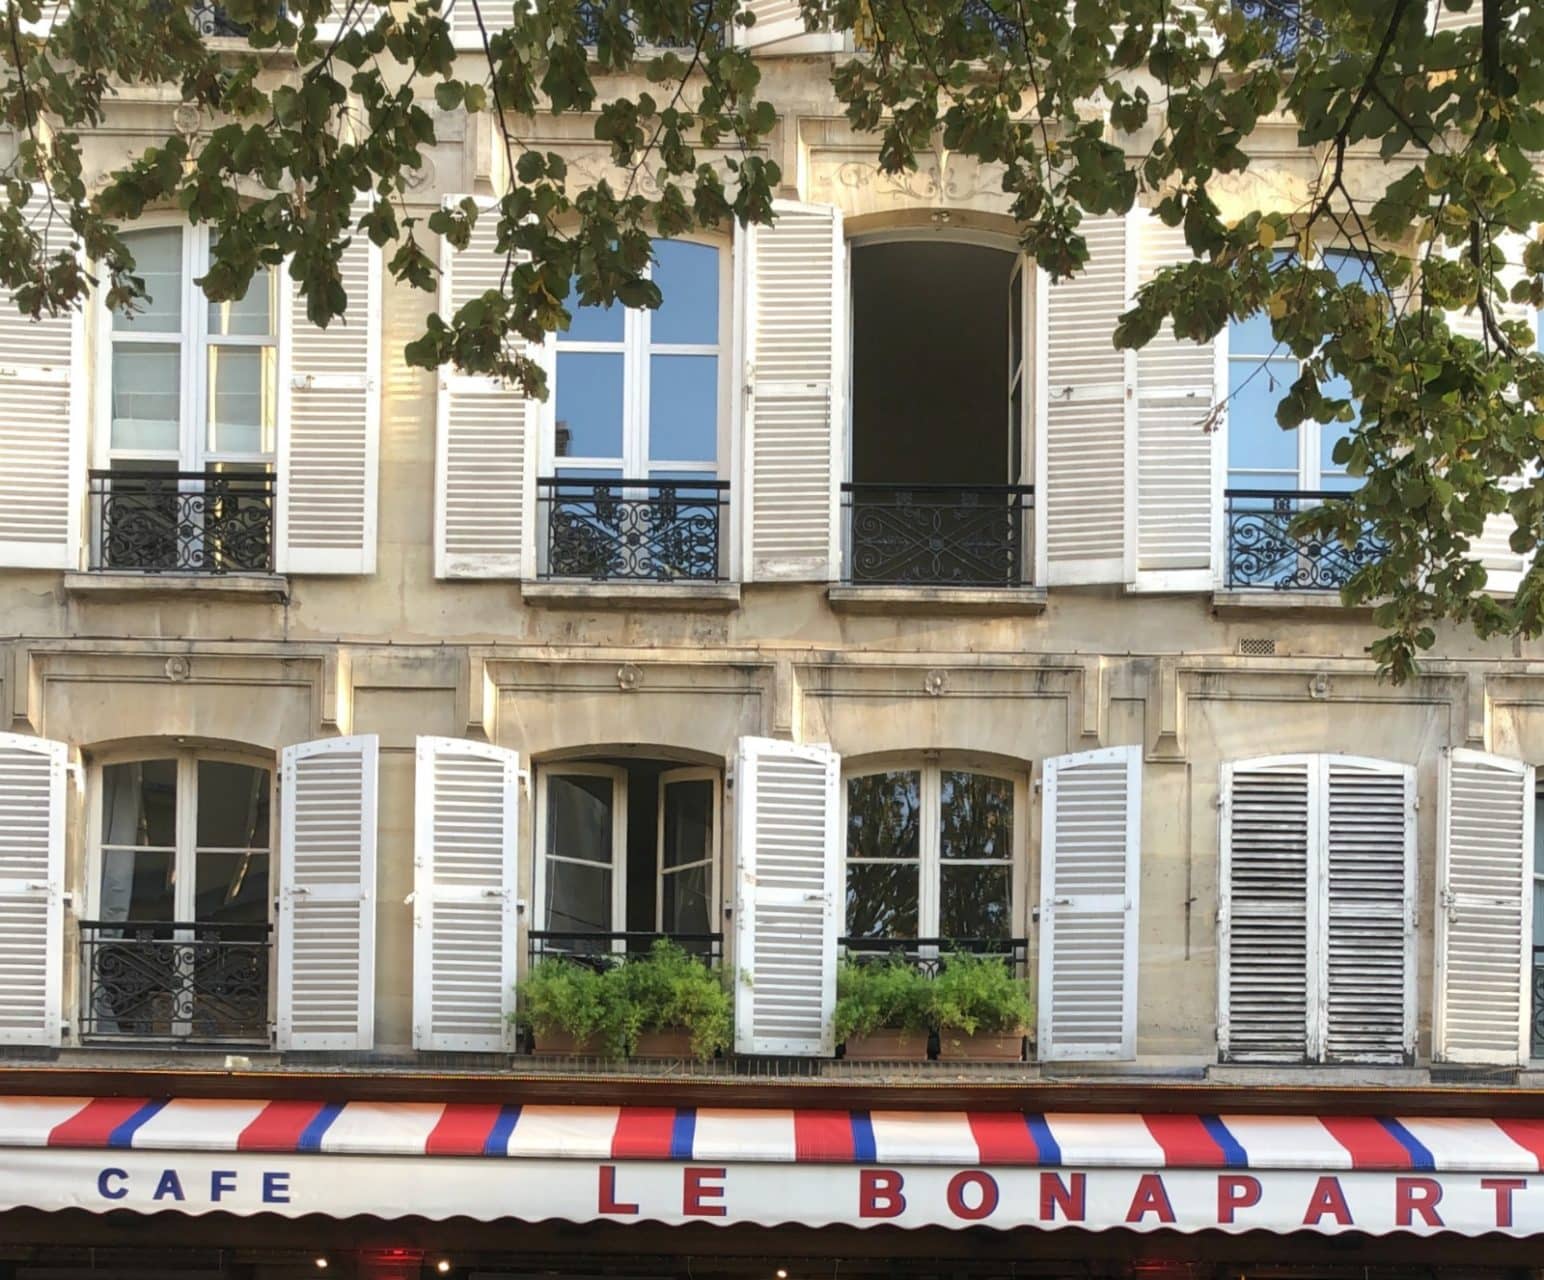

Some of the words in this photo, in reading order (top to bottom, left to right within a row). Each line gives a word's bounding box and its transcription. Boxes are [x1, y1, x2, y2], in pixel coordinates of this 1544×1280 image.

[97, 1167, 291, 1203] CAFE
[597, 1164, 728, 1217] LE
[858, 1168, 1528, 1229] BONAPART
